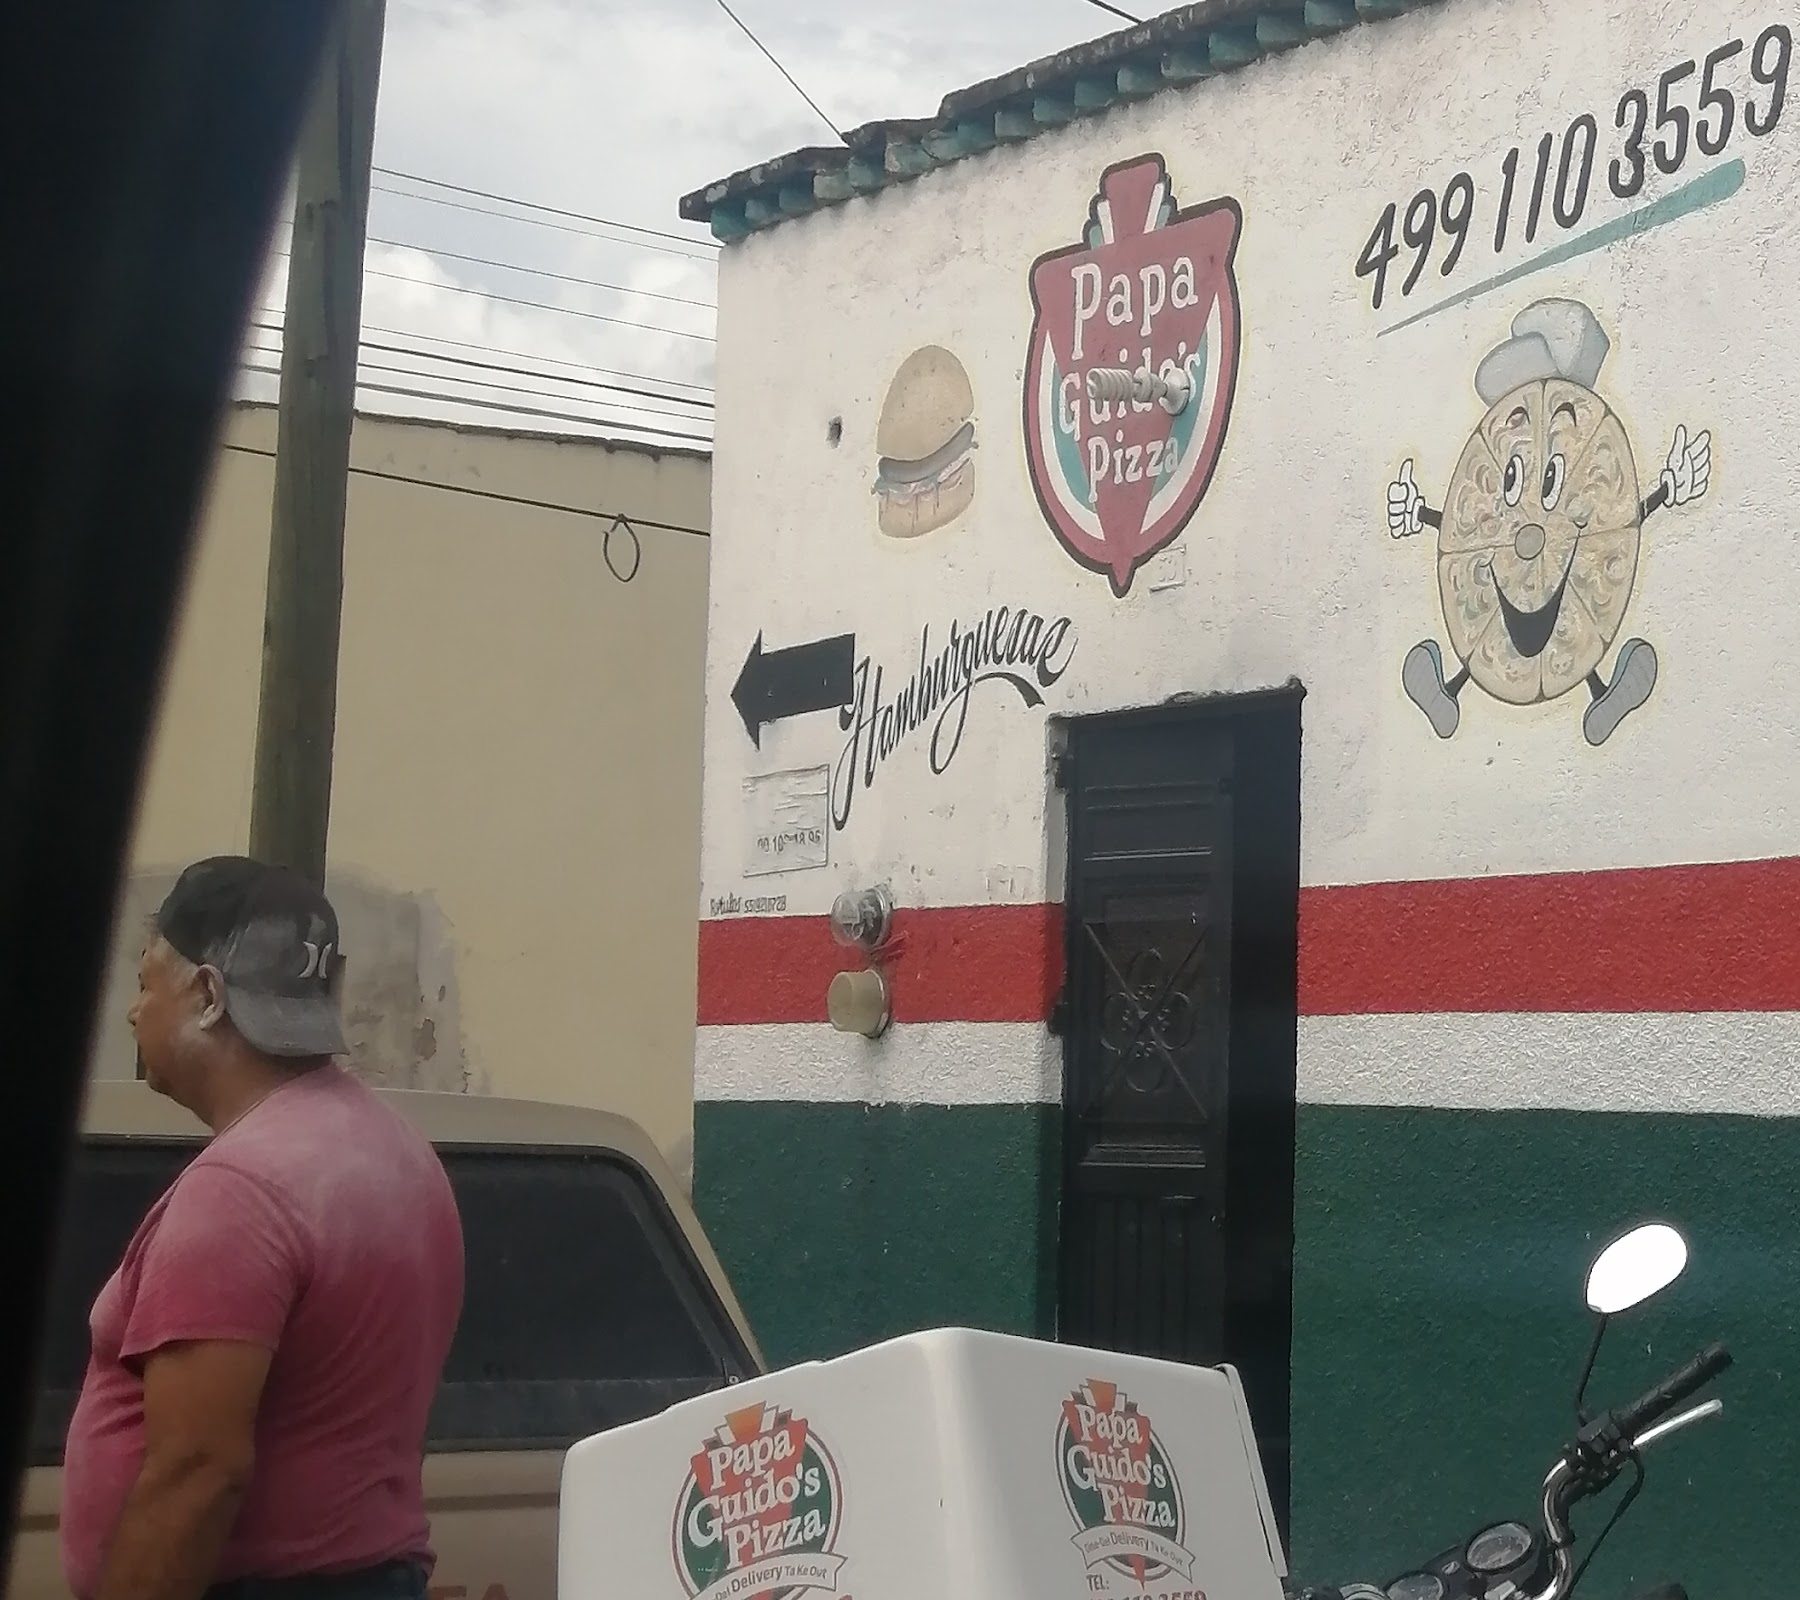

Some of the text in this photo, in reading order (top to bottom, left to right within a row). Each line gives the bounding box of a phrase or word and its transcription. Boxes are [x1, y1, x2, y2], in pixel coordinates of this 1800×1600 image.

[1355, 24, 1793, 310] 499 110 3559
[1071, 257, 1199, 361] Papa
[1088, 429, 1181, 503] Pizza
[832, 605, 1079, 832] Hamburguesas
[1075, 1404, 1142, 1448] Papa
[707, 1429, 795, 1491] Papa
[1067, 1445, 1166, 1491] Guido's
[688, 1462, 821, 1548] Guido's
[1098, 1482, 1175, 1527] Pizza
[724, 1508, 826, 1570] Pizza
[1110, 1531, 1149, 1551] Delivery
[731, 1565, 783, 1593] Delivery
[1086, 1574, 1110, 1591] TEL:
